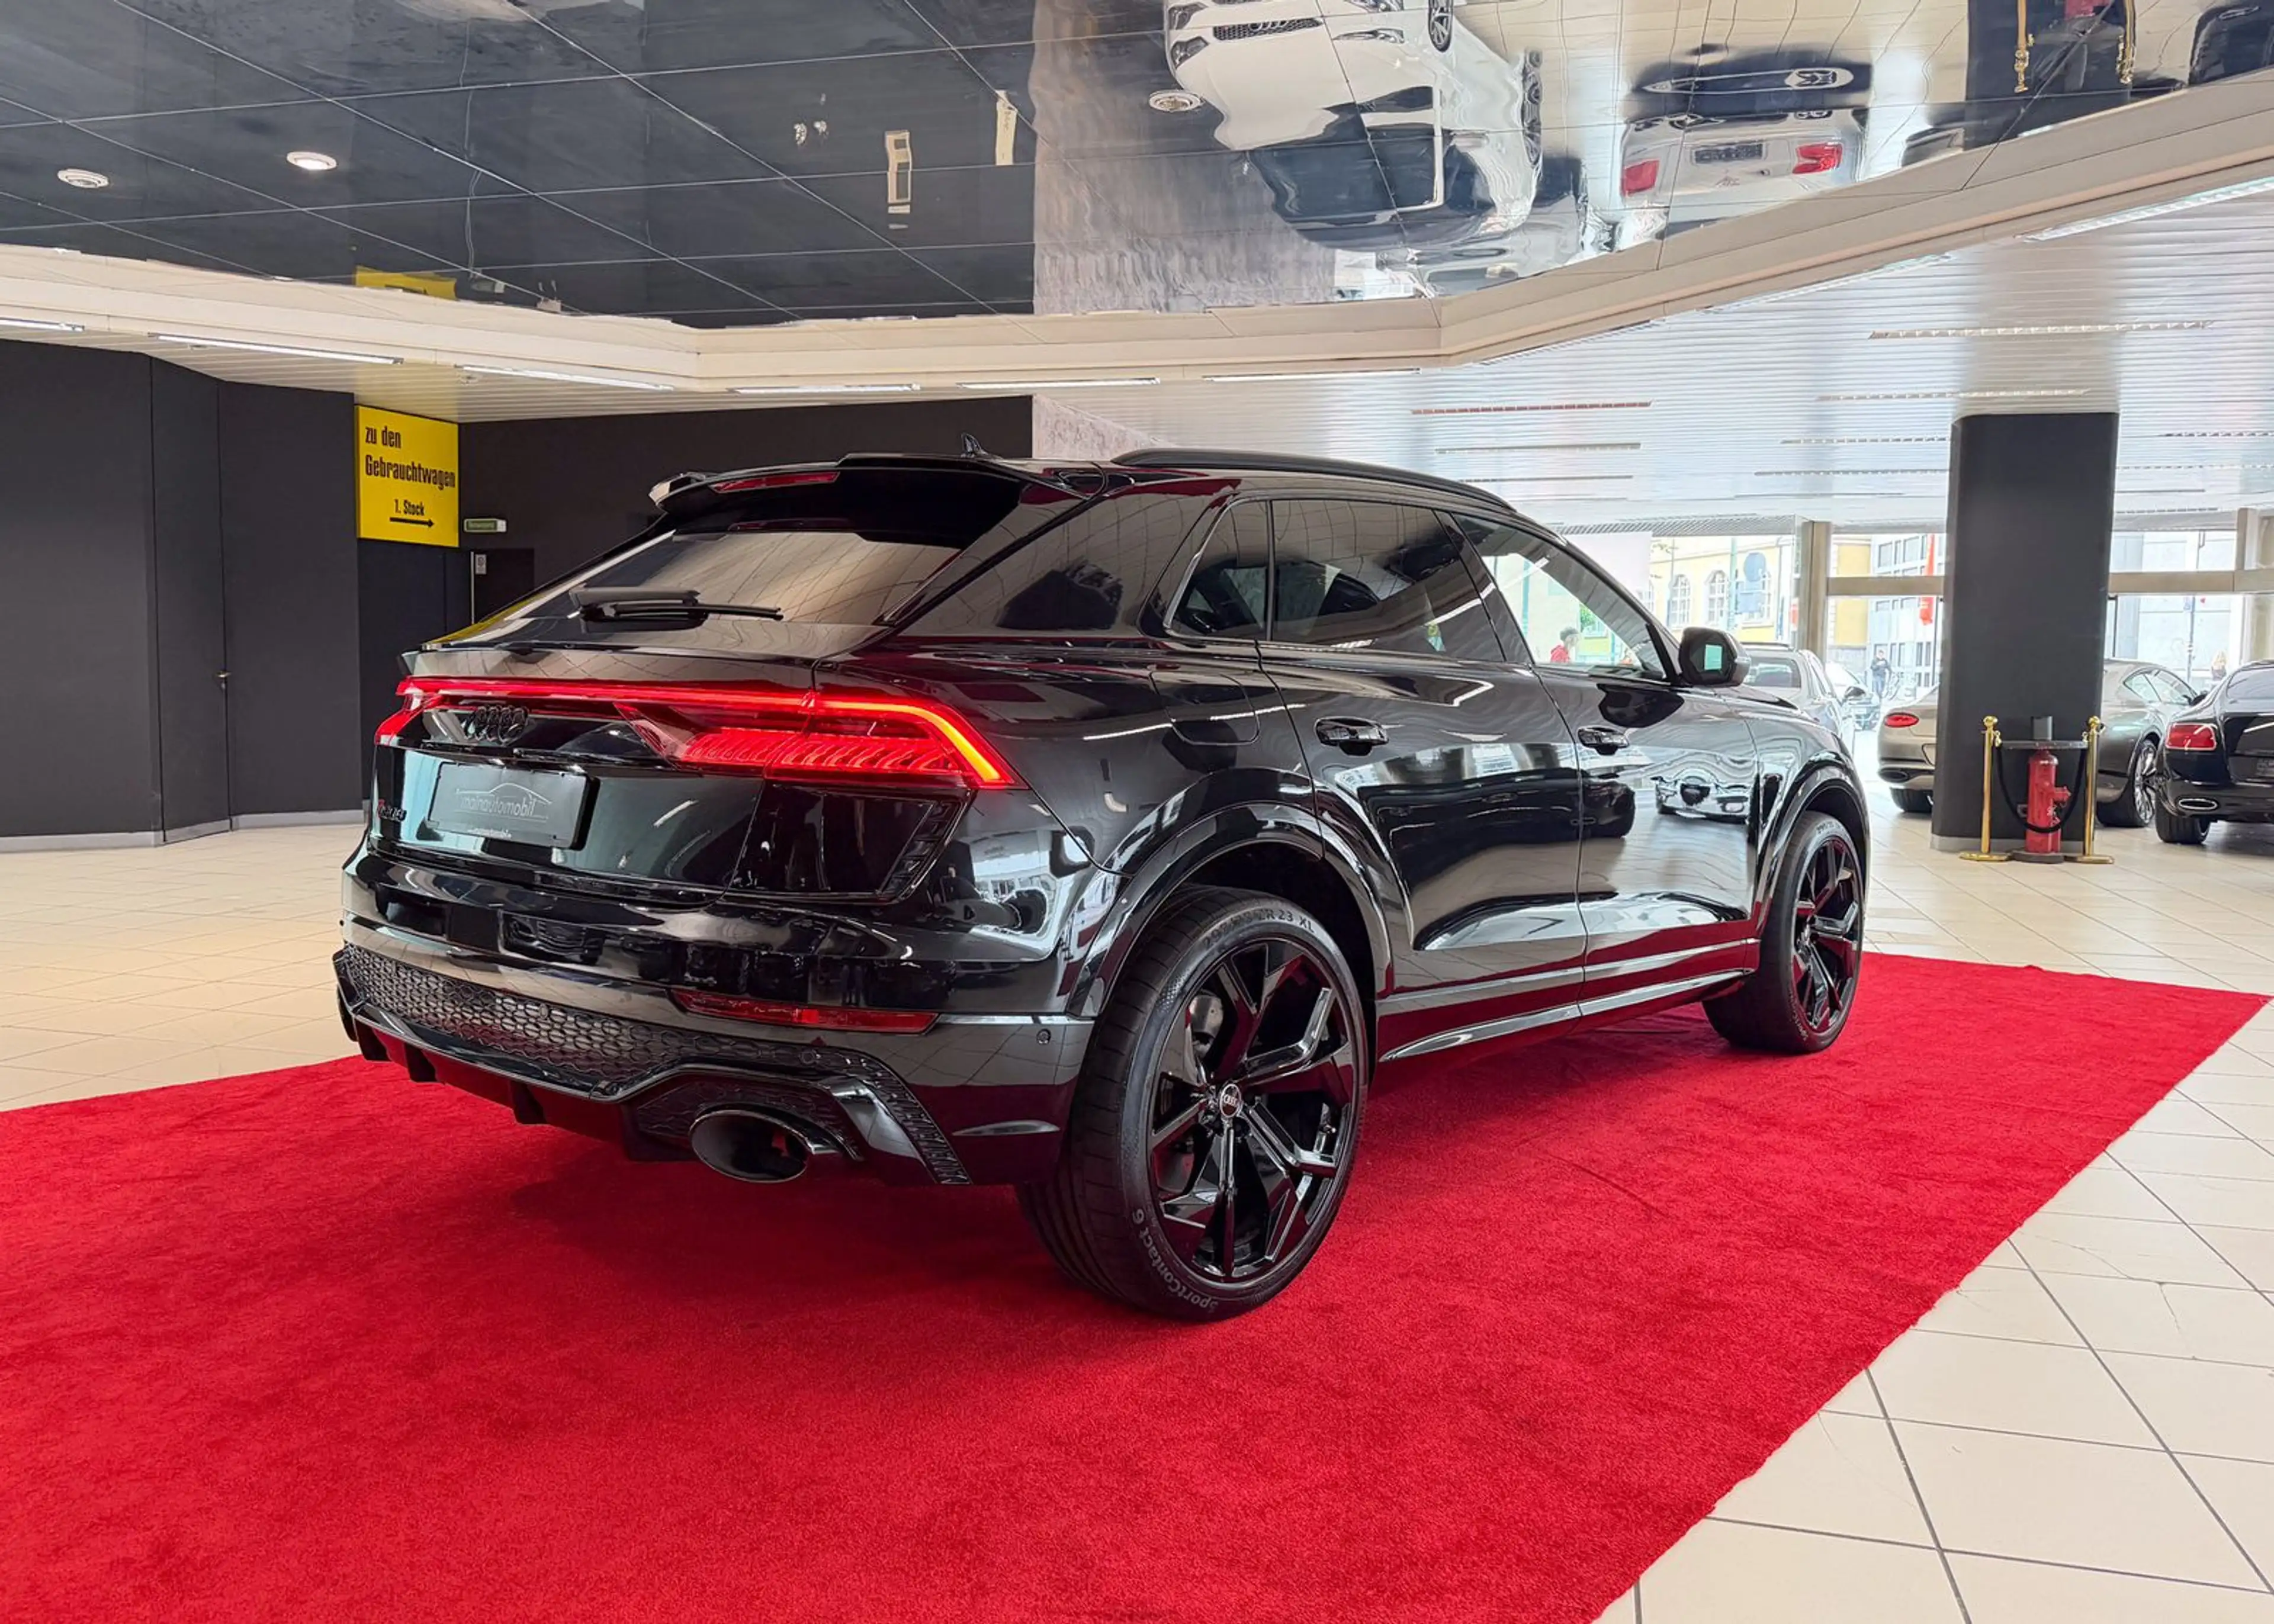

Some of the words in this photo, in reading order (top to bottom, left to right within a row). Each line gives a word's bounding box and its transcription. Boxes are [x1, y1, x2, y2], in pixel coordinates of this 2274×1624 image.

[365, 426, 377, 444] zu
[381, 426, 402, 449] den
[365, 454, 455, 491] Gebrauchtwagen
[394, 499, 402, 514] 1.
[403, 499, 425, 516] Stock
[1279, 909, 1293, 922] 23
[1299, 915, 1315, 934] XL
[1132, 1208, 1145, 1225] 6
